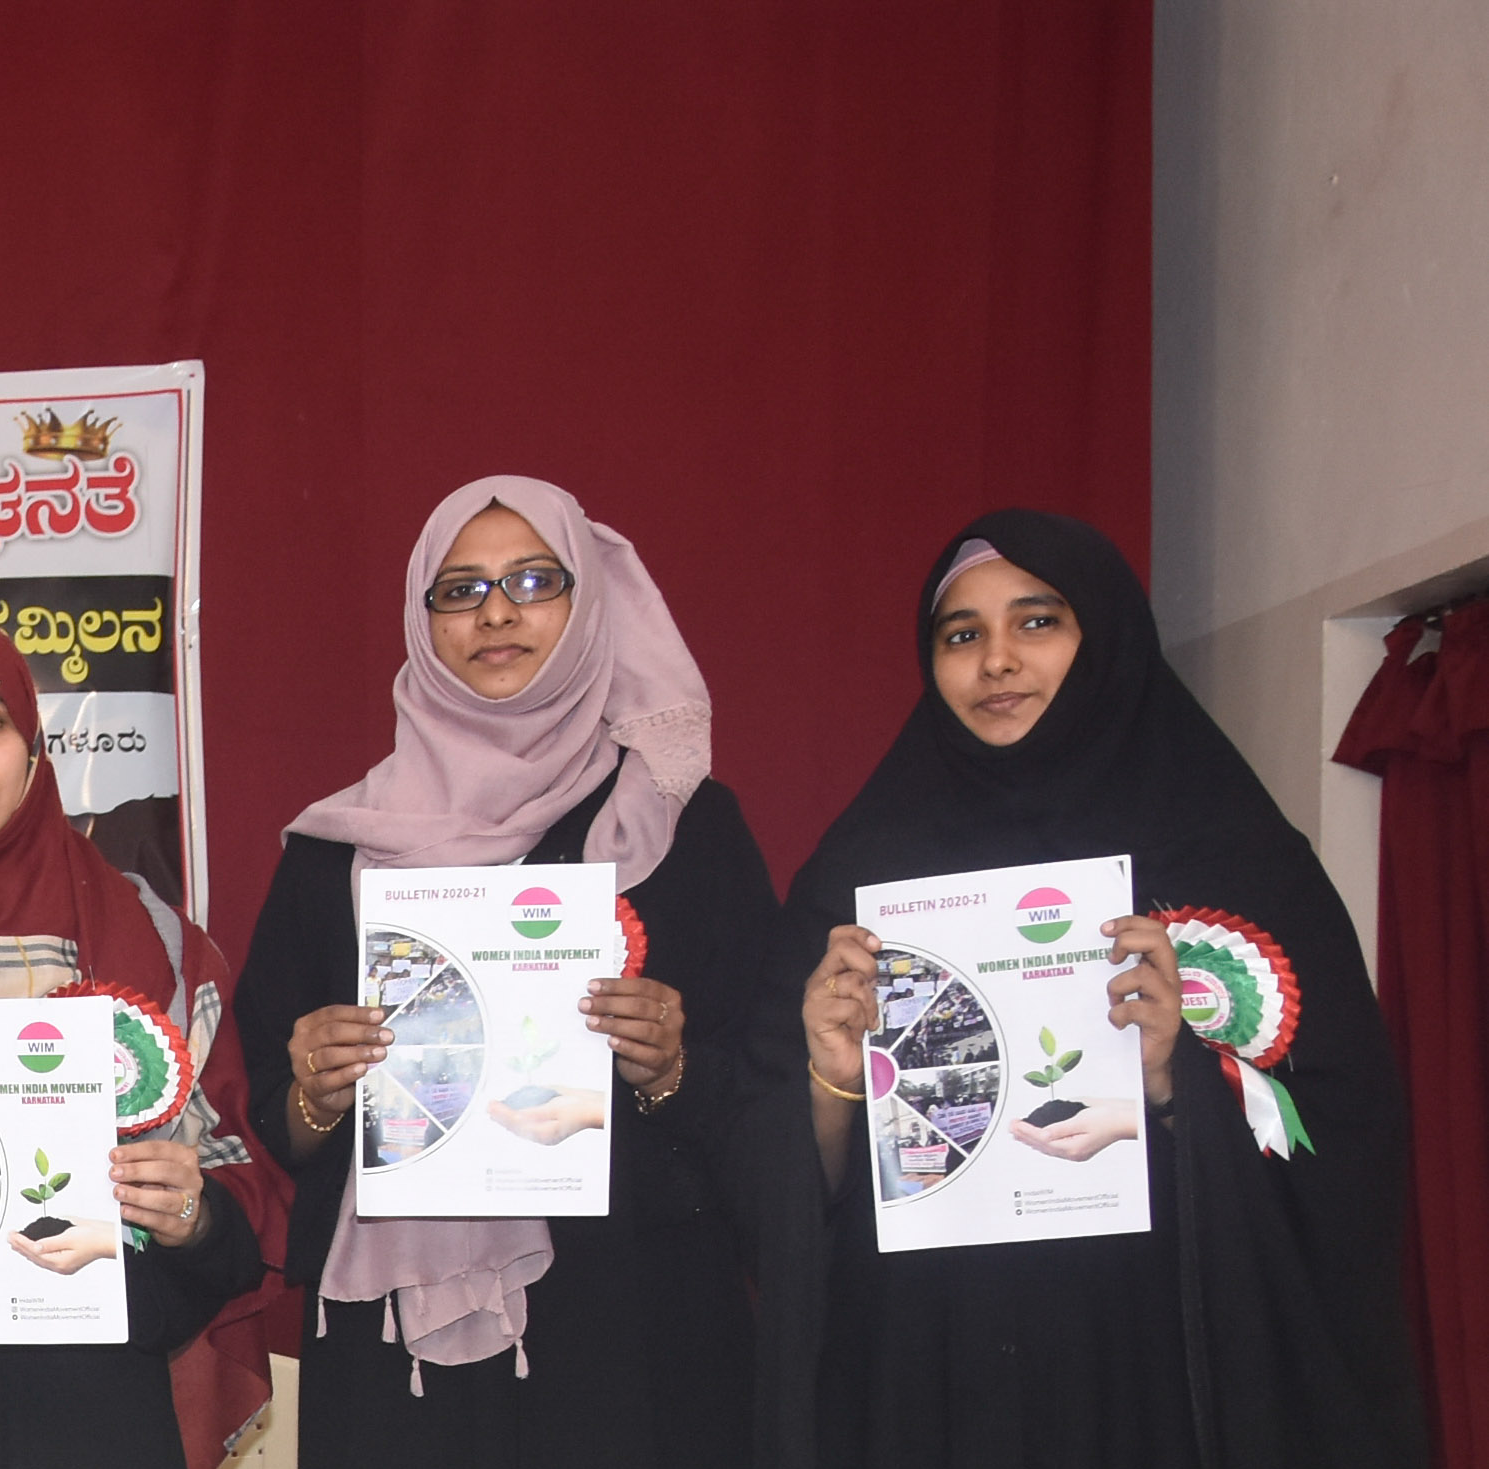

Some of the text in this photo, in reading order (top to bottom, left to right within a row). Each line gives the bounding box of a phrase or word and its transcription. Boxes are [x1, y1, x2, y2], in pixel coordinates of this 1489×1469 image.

[386, 888, 485, 900] BULLETIN 2020-21
[880, 893, 986, 916] BULLETIN 2020-21
[523, 908, 551, 918] WIM
[1028, 909, 1060, 922] WIM
[472, 949, 600, 961] WOMEN INDIA MOVEMENT
[977, 959, 1019, 973] WOMEN
[1023, 955, 1054, 969] INDIA
[28, 1043, 54, 1052] WIM
[22, 1084, 48, 1094] INDIA
[50, 1083, 102, 1093] MOVEMENT
[22, 1096, 65, 1104] KARNATAKA
